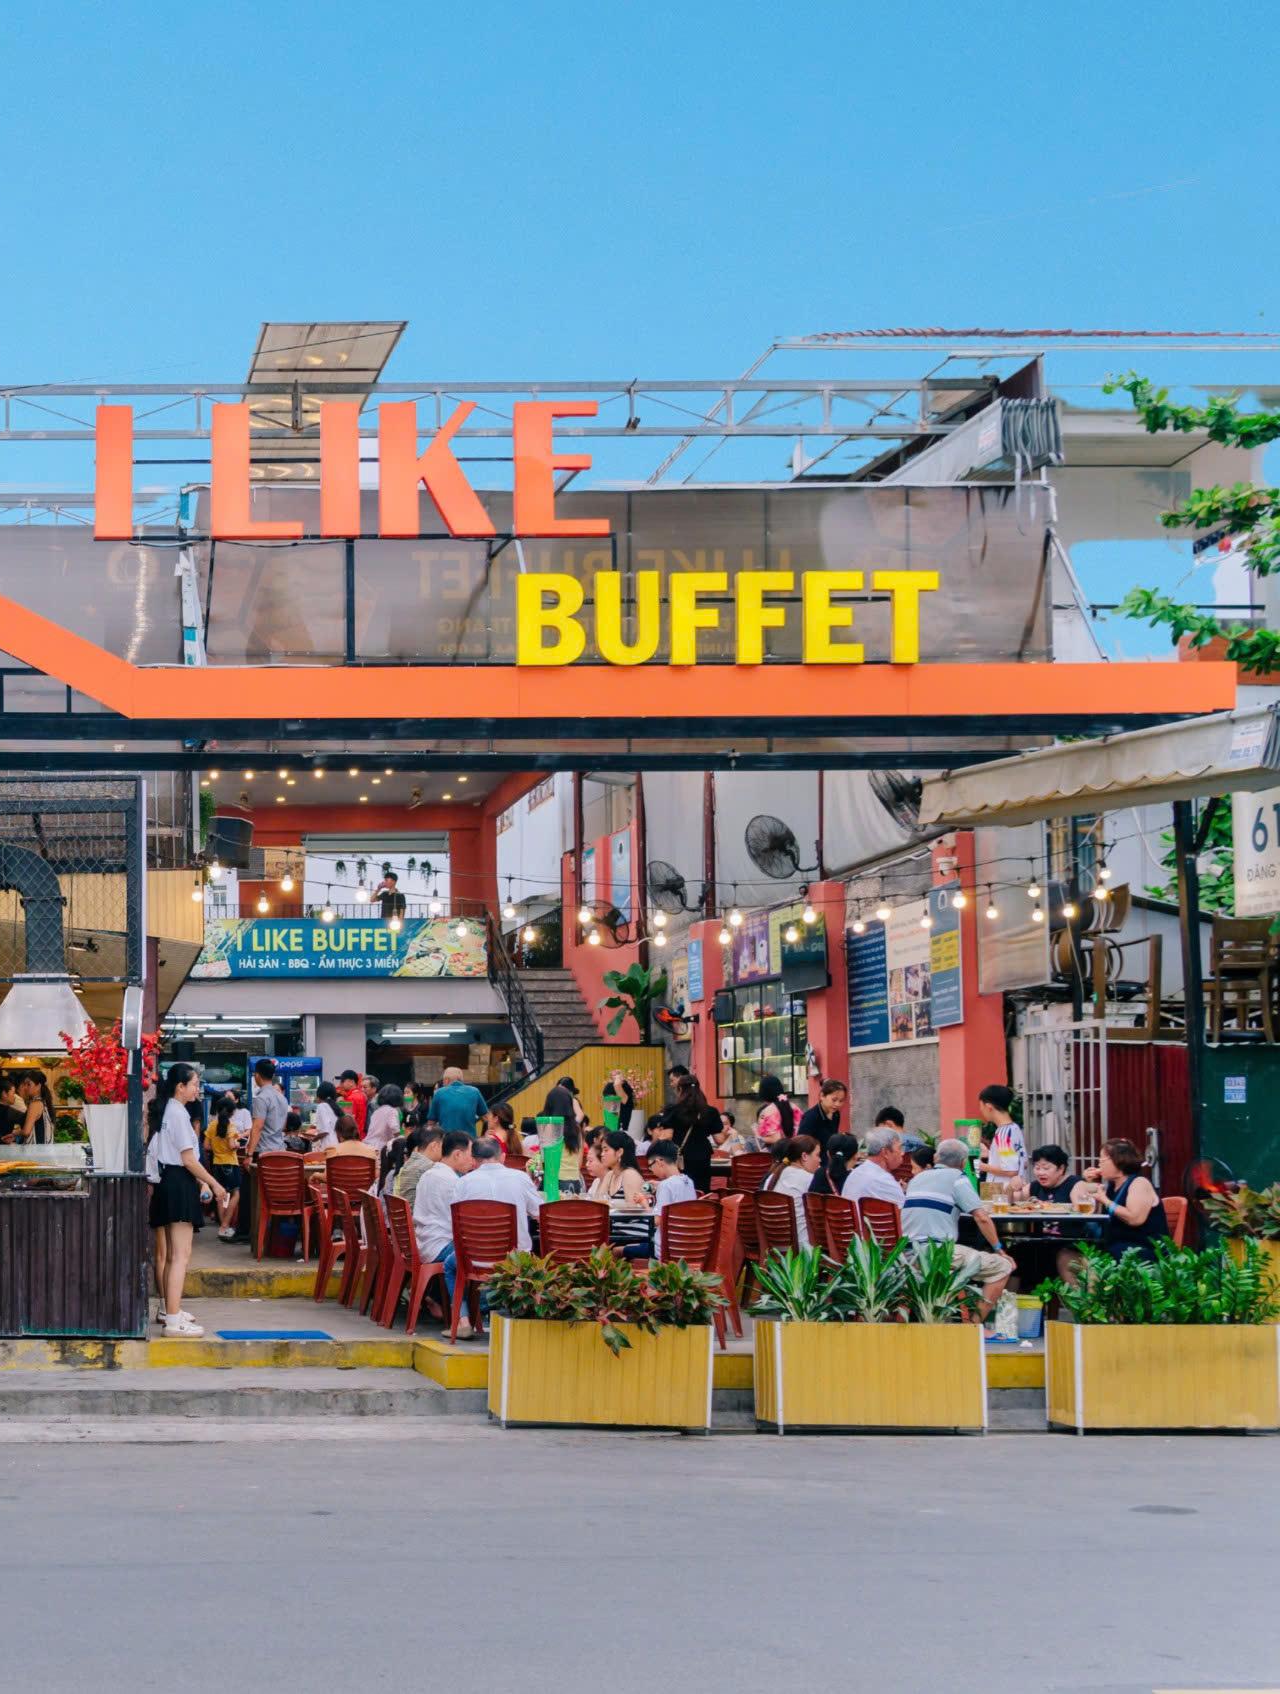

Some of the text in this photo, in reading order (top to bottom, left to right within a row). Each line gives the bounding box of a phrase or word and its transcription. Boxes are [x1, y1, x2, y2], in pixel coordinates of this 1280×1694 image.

[94, 401, 610, 541] I LIKE
[517, 571, 939, 666] BUFFET
[237, 928, 401, 951] I LIKE BUFFET
[239, 955, 256, 969] HẢI
[258, 955, 280, 969] SẢN
[288, 958, 310, 969] BBQ
[337, 957, 364, 971] THỰC
[366, 958, 372, 969] 3
[279, 1060, 304, 1070] pepsi
